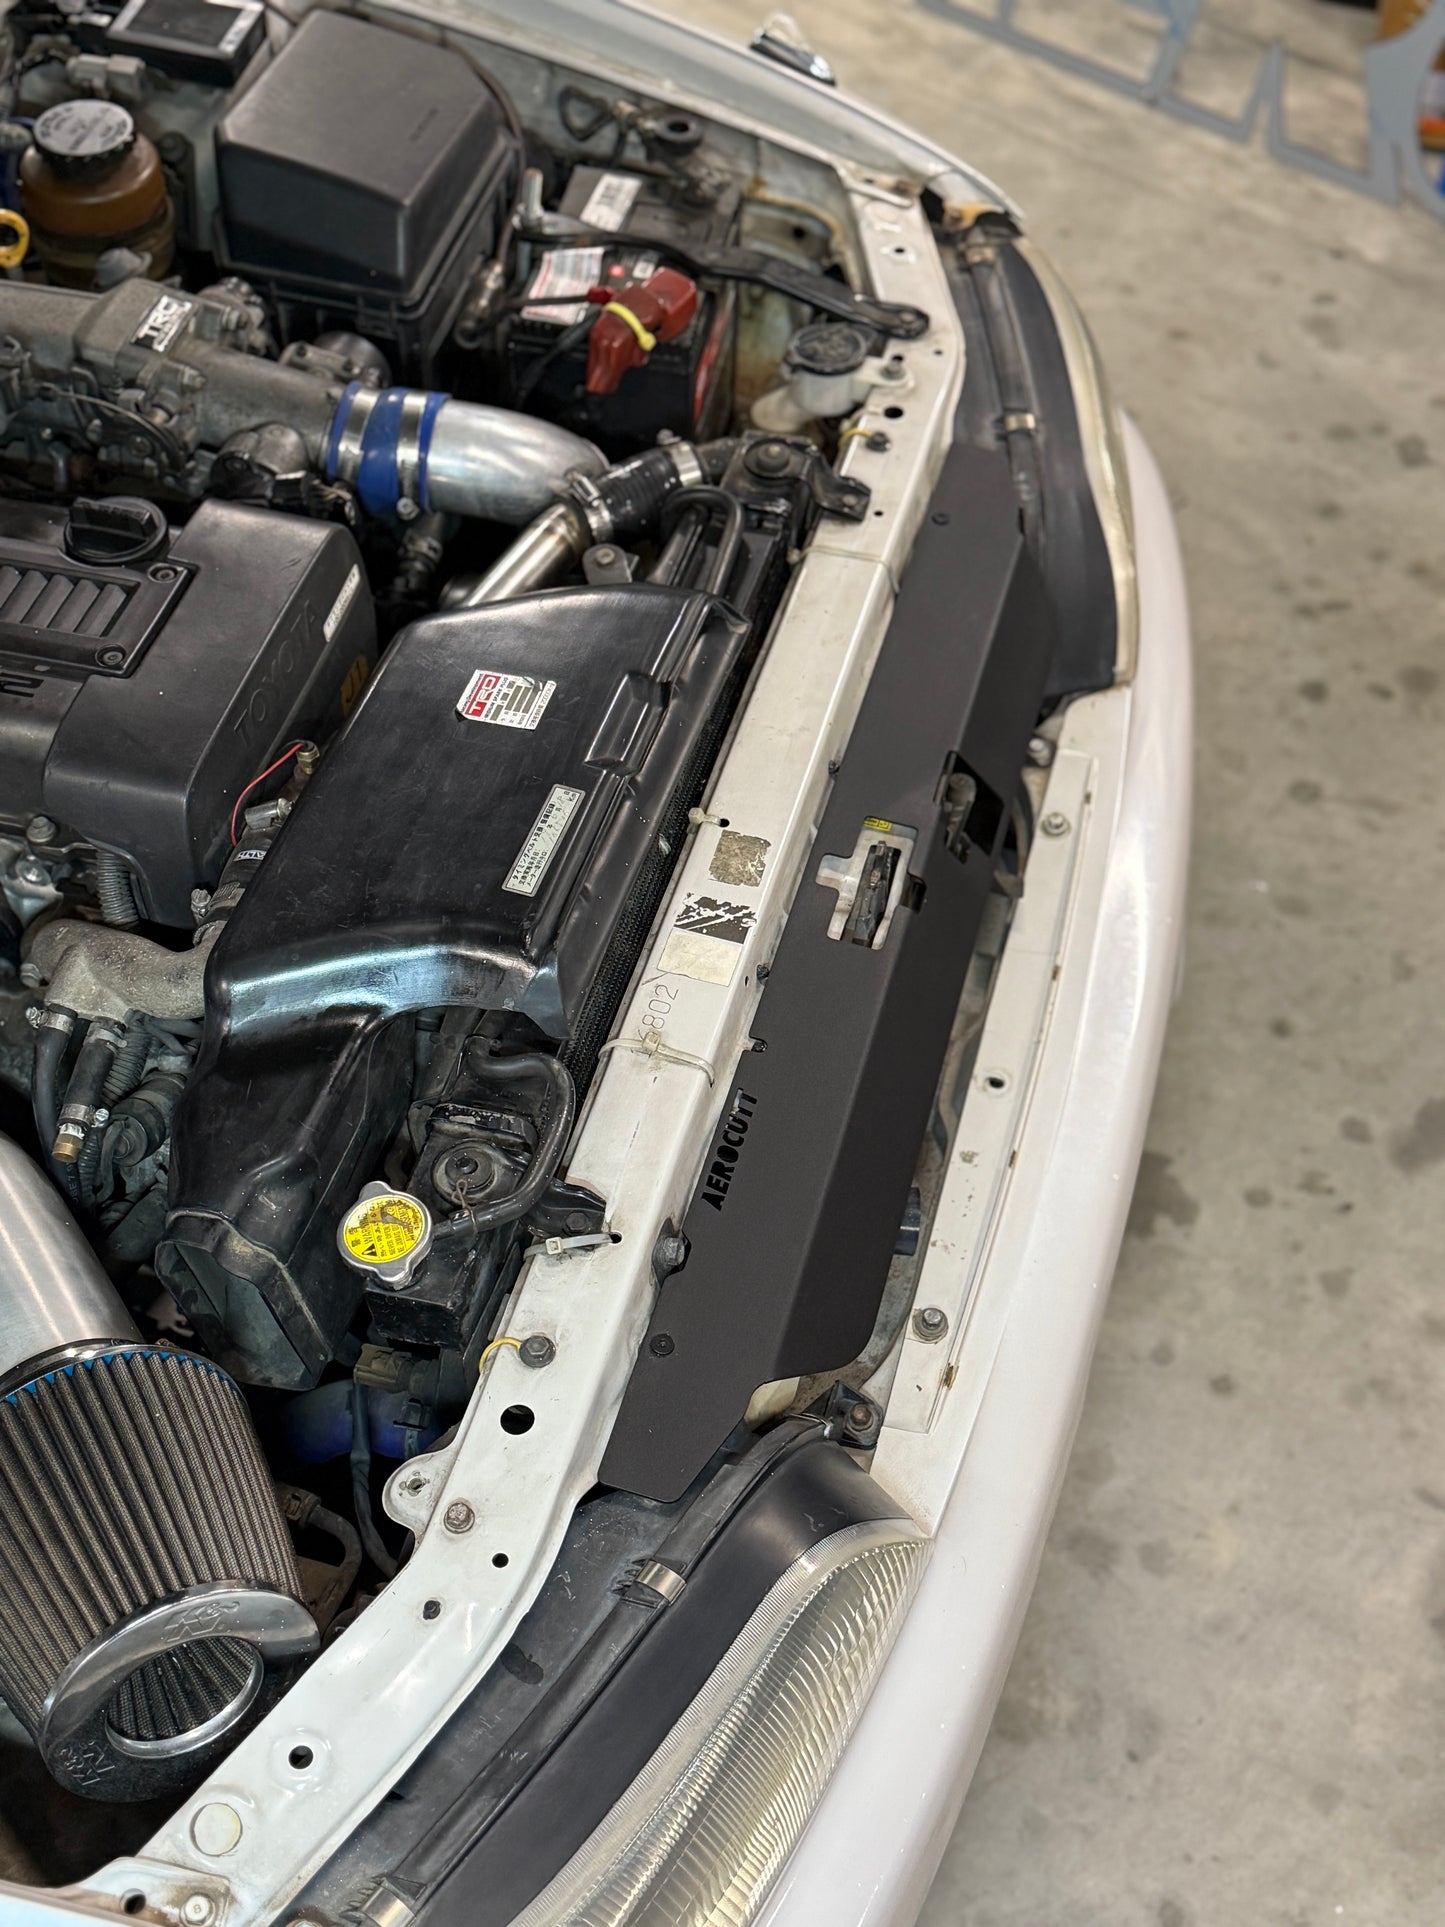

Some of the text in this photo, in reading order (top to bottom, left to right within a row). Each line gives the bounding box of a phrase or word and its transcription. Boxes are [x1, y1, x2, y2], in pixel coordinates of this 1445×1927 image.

[233, 599, 314, 746] TOYOTA
[468, 677, 497, 714] TRD
[701, 1087, 758, 1212] AEROCUTT
